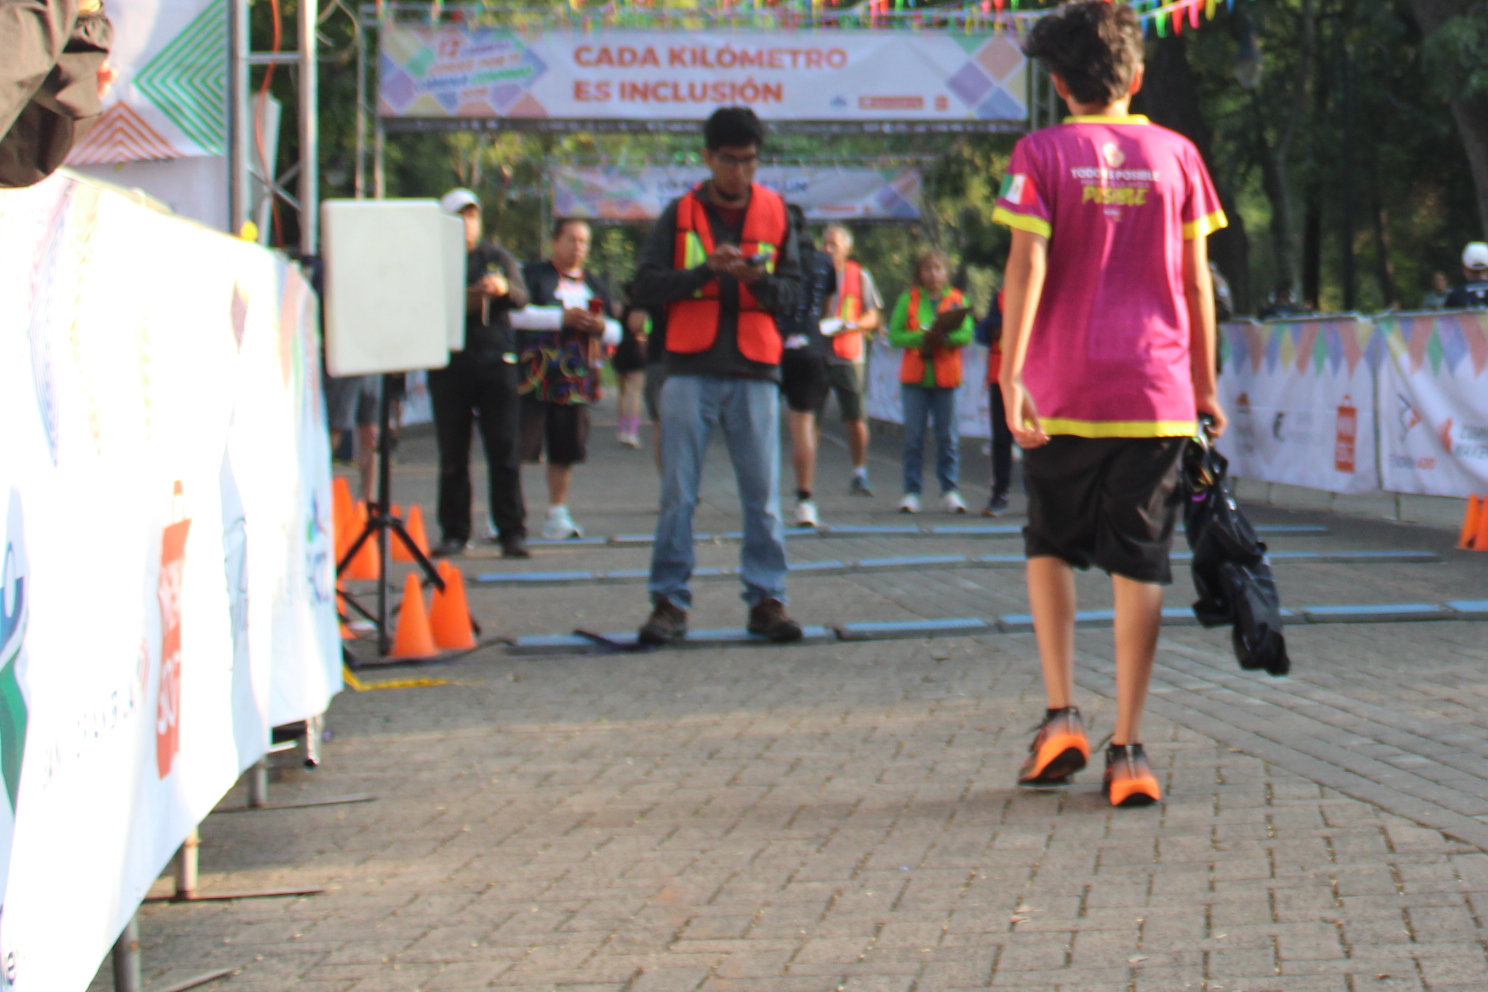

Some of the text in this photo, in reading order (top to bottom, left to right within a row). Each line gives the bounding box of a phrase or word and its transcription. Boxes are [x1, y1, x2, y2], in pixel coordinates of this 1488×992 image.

[574, 39, 848, 70] CADA KILÓMETRO
[573, 76, 784, 105] ES INCLUSIÓN
